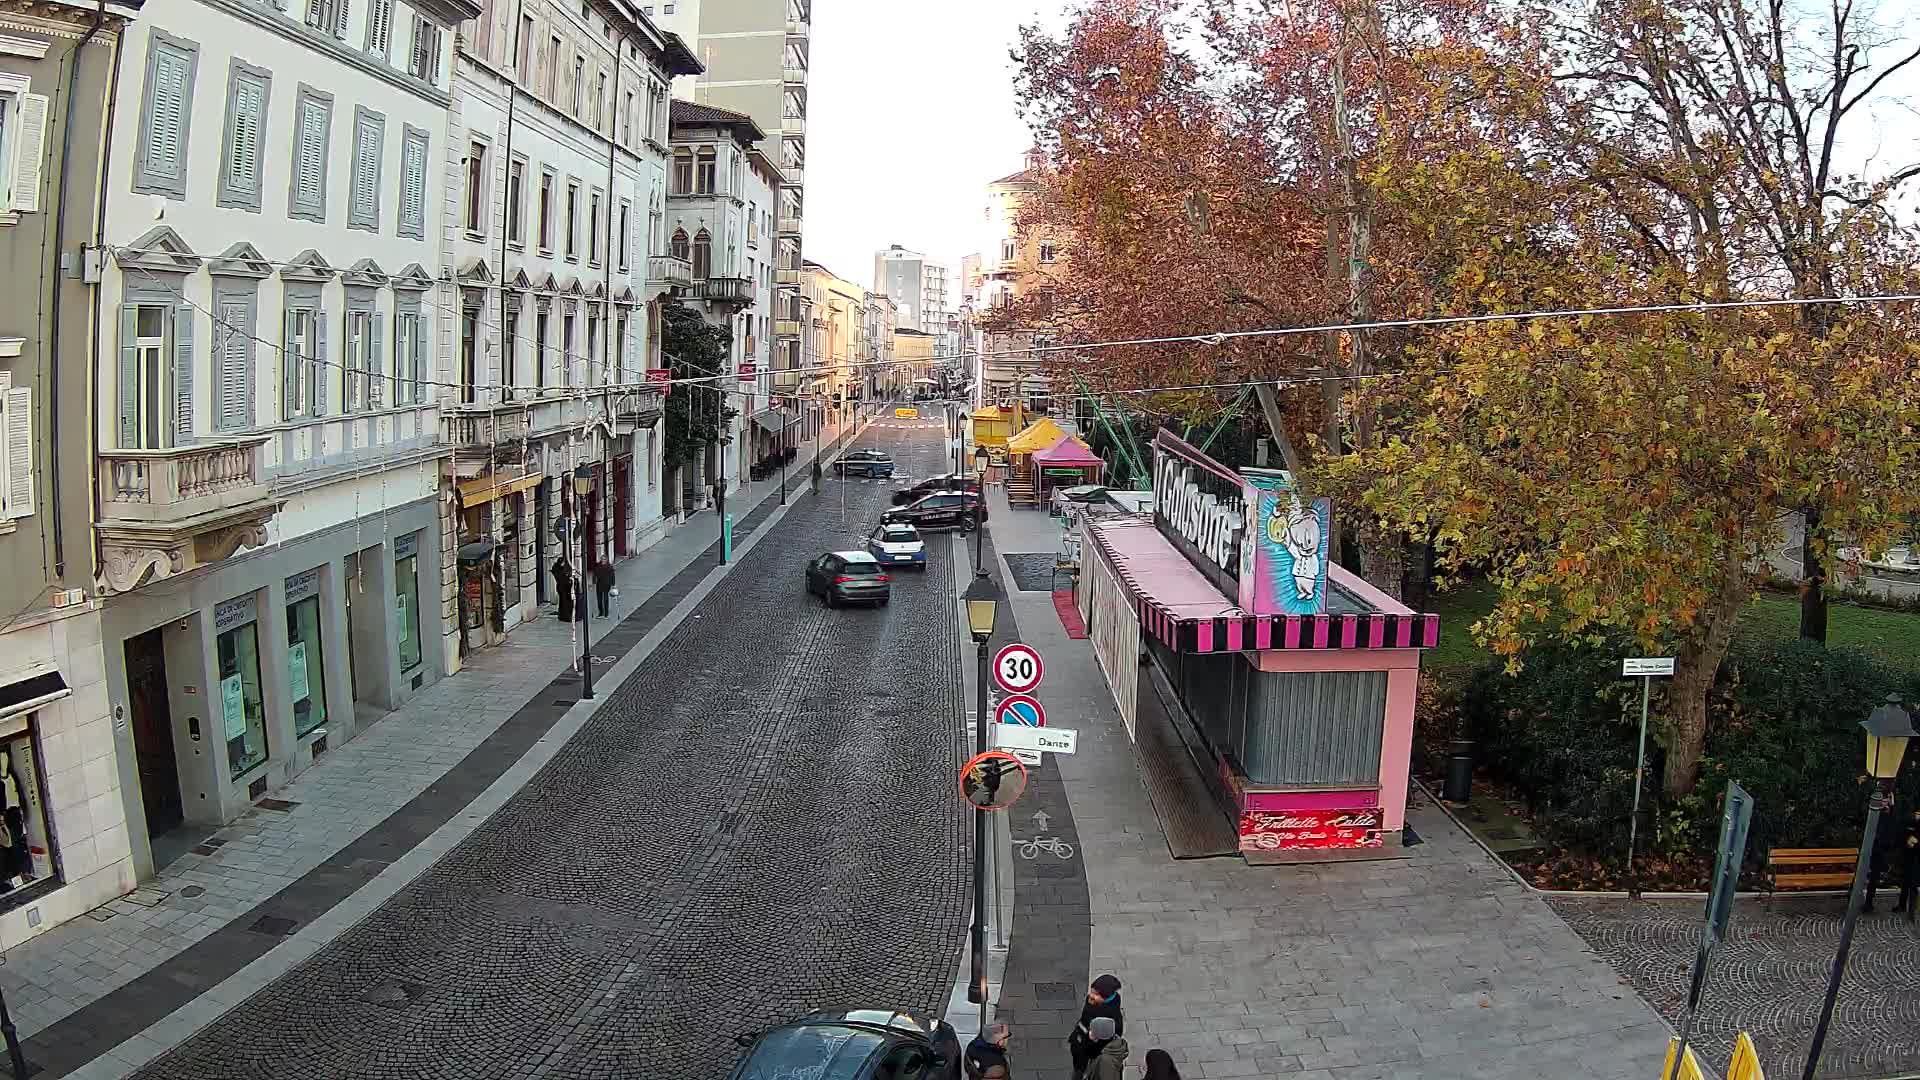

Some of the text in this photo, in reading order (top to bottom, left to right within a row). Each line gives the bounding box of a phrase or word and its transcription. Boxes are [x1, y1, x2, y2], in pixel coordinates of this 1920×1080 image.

[1163, 459, 1233, 569] Golosone
[1005, 658, 1033, 680] 30
[1038, 737, 1070, 749] Dante
